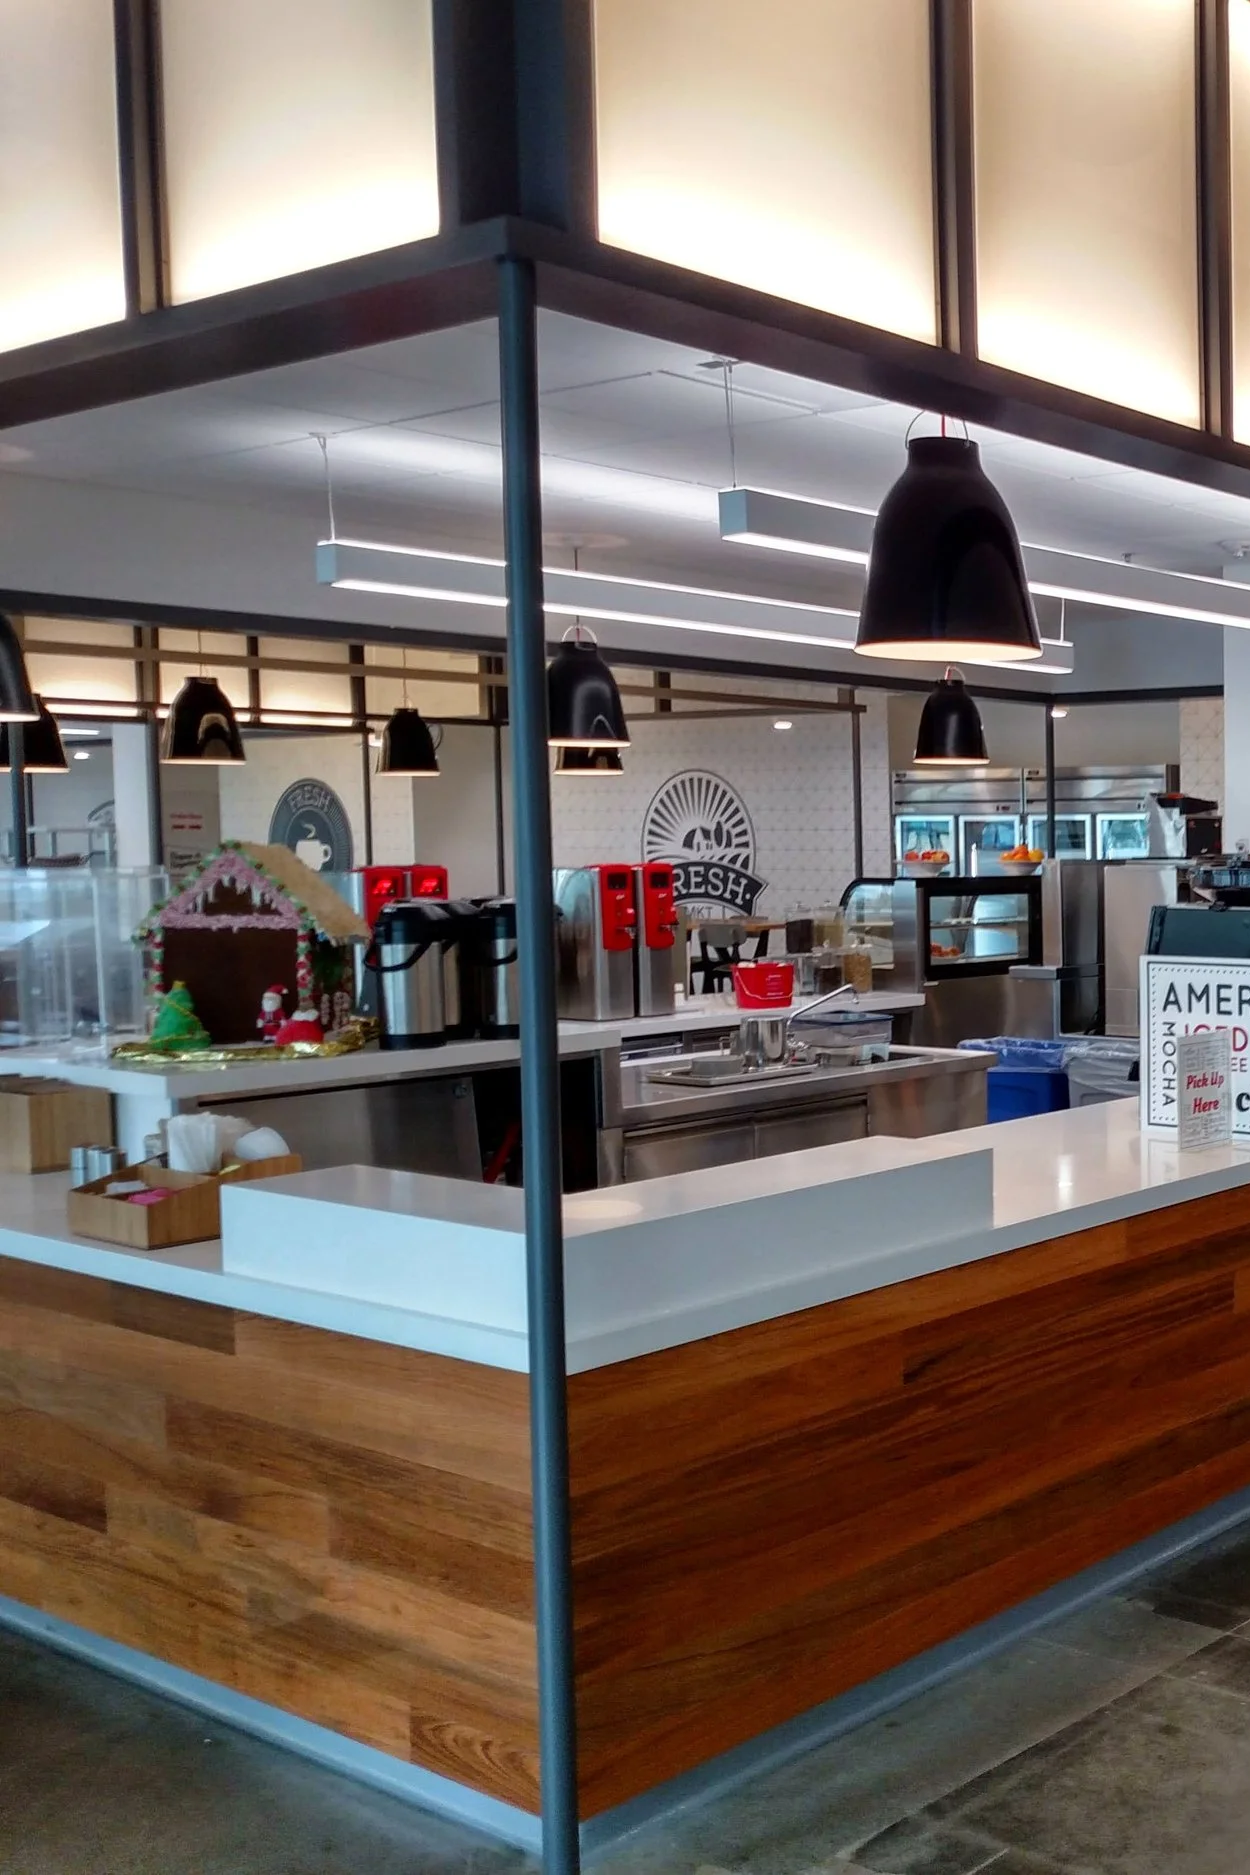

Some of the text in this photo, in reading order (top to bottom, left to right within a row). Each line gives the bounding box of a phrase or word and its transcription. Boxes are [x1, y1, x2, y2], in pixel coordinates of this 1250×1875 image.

[1162, 1021, 1177, 1107] MOCHA
[1186, 1071, 1225, 1090] Pick Up
[1193, 1096, 1220, 1115] Here
